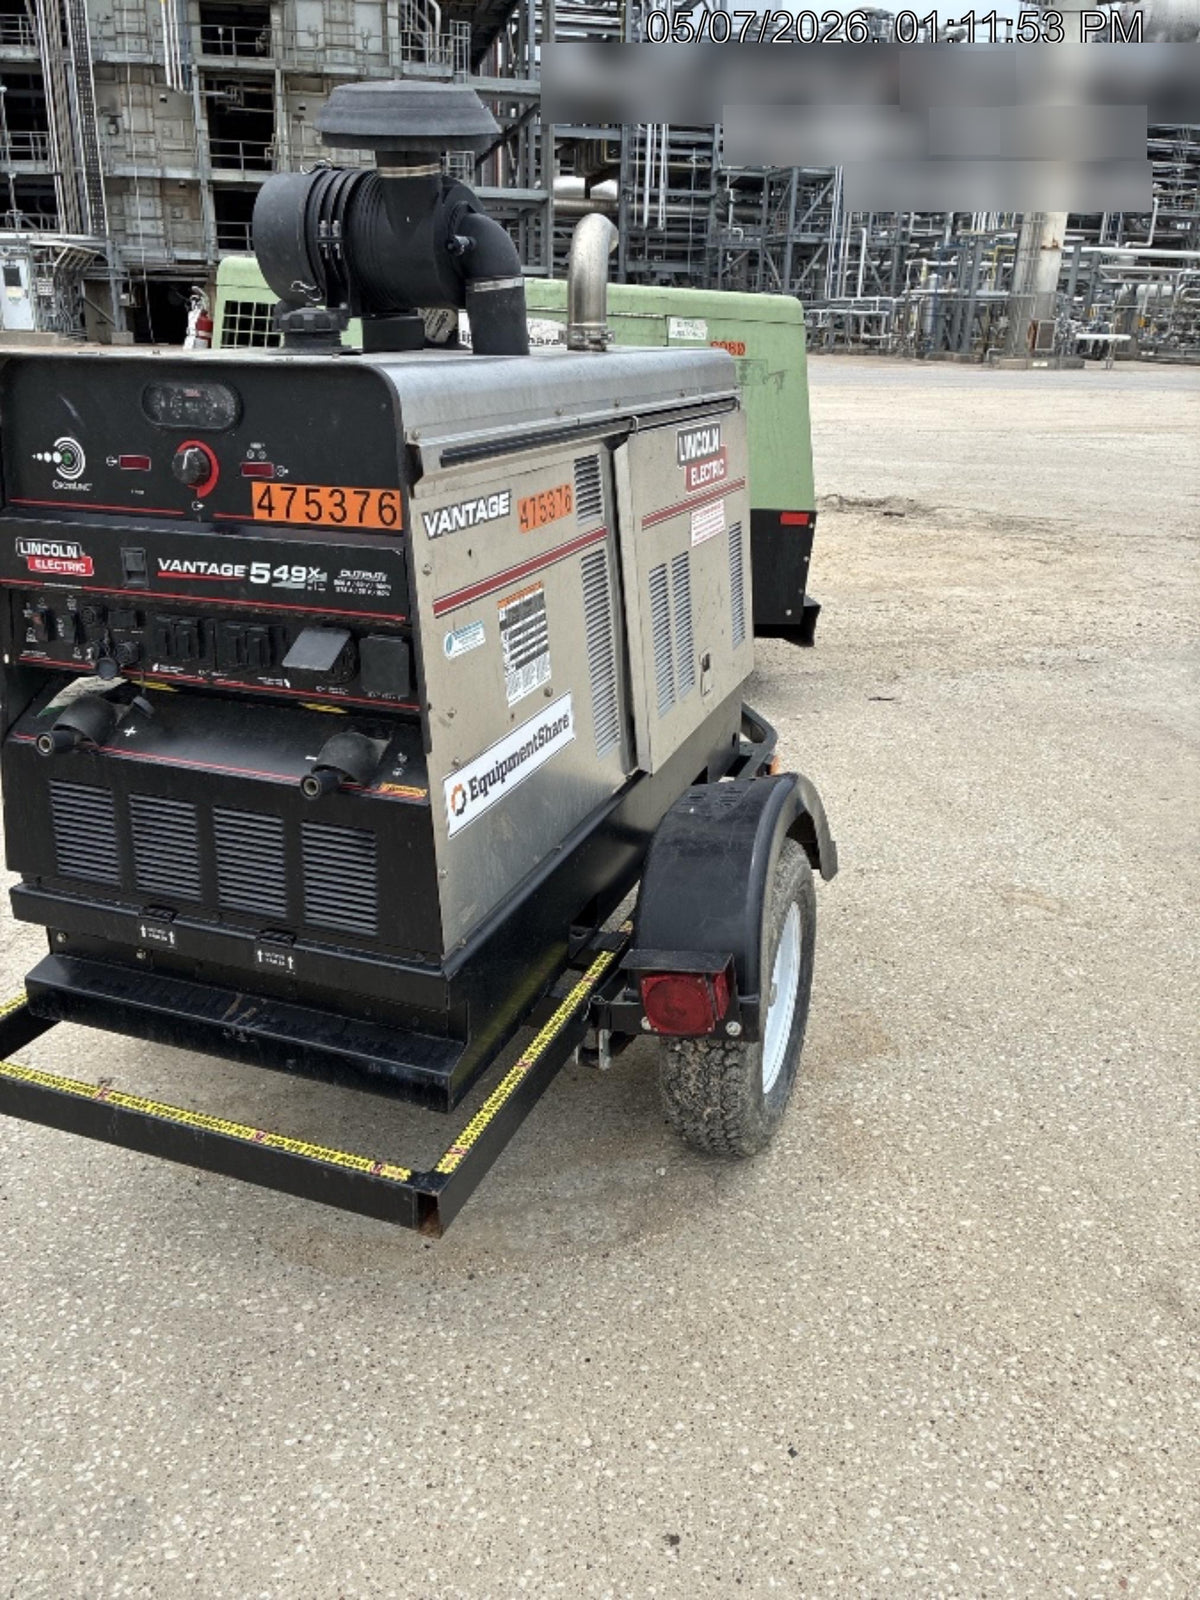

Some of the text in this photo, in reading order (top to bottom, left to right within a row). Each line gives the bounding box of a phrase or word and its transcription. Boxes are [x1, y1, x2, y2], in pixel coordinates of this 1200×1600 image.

[678, 426, 720, 462] LINCOLN
[690, 458, 725, 487] ELECTRIC
[257, 484, 398, 526] 475376
[423, 491, 511, 538] VANTAGE
[519, 484, 573, 529] 475376
[19, 541, 78, 559] LINCOLN
[34, 558, 86, 574] ELECTRIC
[157, 557, 247, 577] VANTAGE
[467, 713, 570, 803] EquipmentShare
